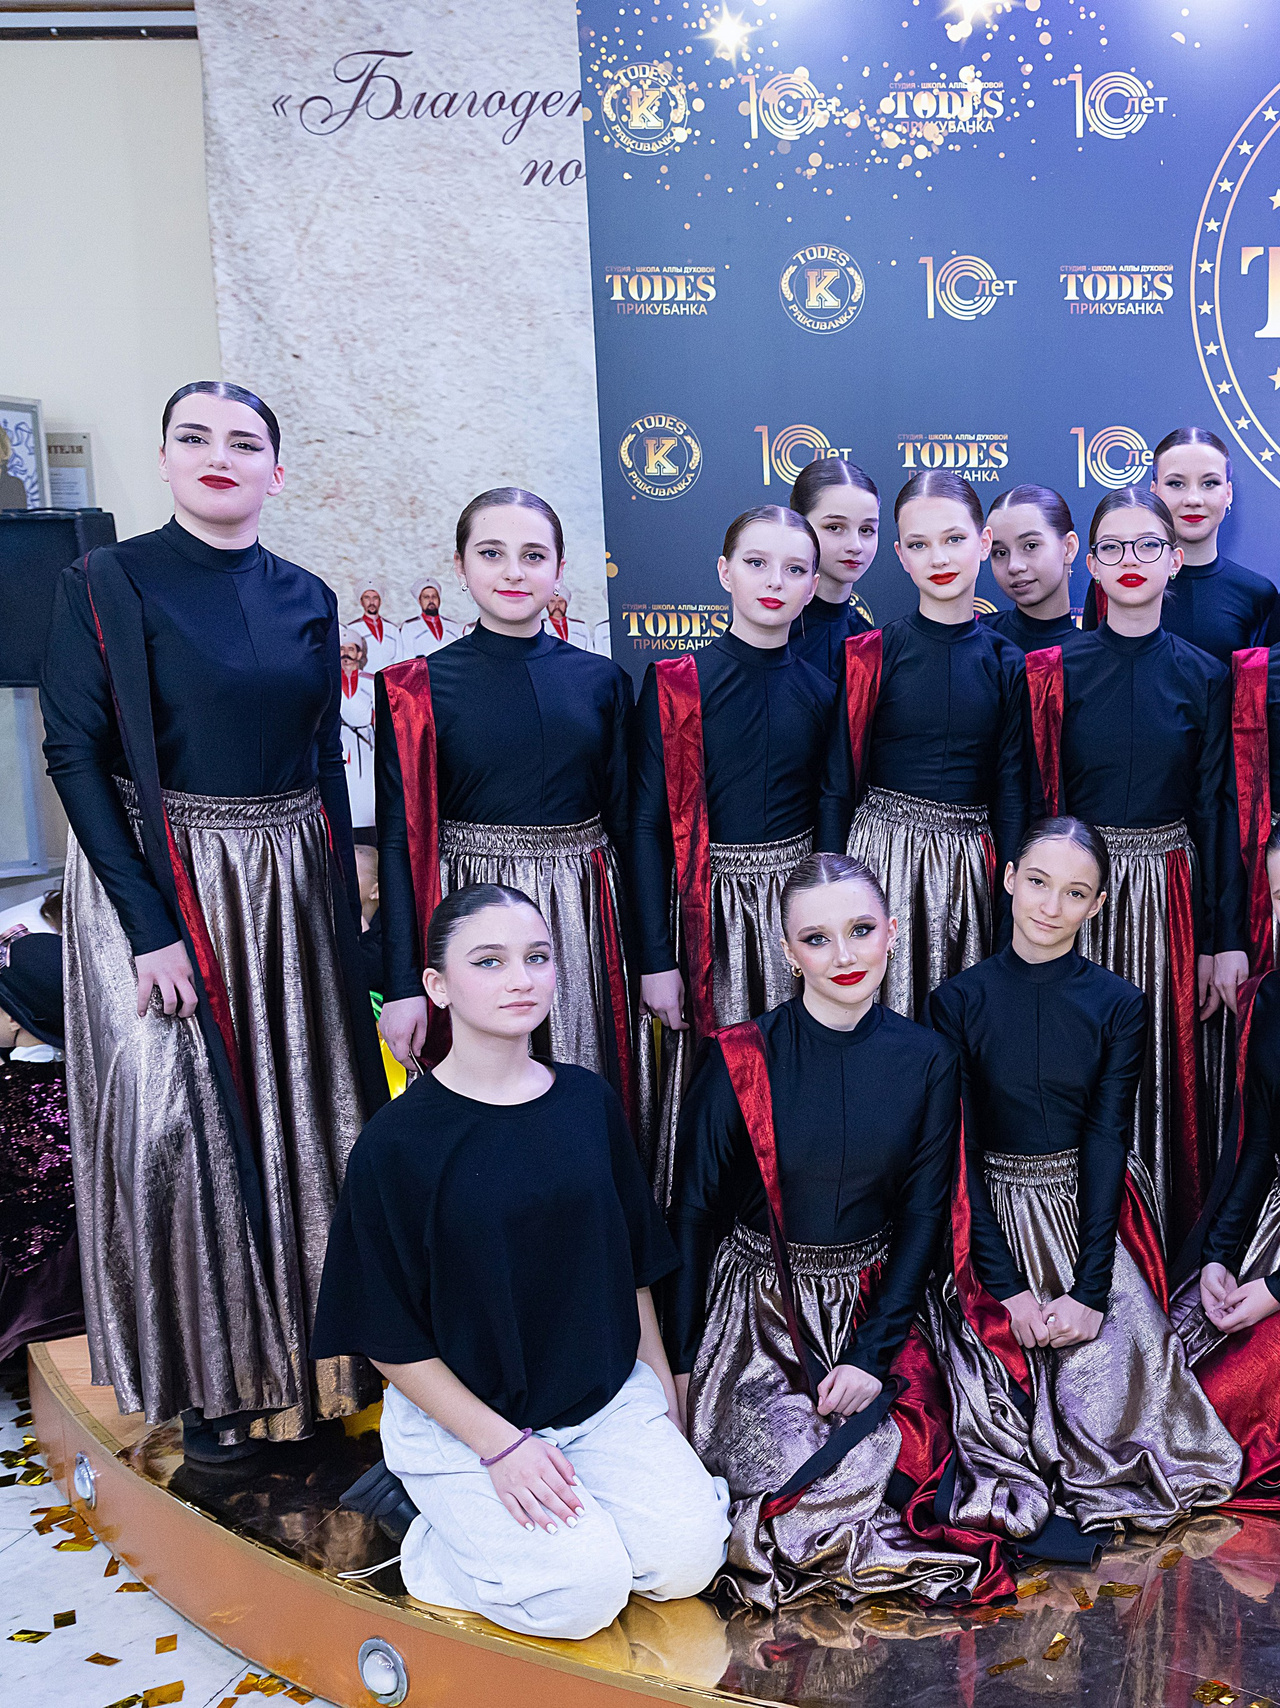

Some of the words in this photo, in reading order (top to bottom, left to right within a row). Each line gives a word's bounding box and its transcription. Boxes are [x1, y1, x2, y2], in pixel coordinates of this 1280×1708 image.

[614, 65, 672, 87] TODES
[627, 88, 664, 129] K
[889, 91, 1005, 119] TODES
[1067, 71, 1148, 139] 10
[1125, 96, 1168, 113] лет
[611, 124, 683, 151] PRIKUBANK
[793, 246, 850, 267] TODES
[605, 274, 717, 301] TODES
[804, 268, 841, 309] K
[918, 255, 998, 320] 10
[976, 279, 1018, 296] лет
[1060, 273, 1174, 301] TODES
[617, 303, 708, 315] ПРИКУБАНКА
[788, 304, 858, 331] PRIKUBANKA
[1070, 303, 1164, 315] ПРИКУБАНКА
[631, 414, 687, 436] TODES
[644, 437, 679, 476] K
[897, 441, 1009, 468] TODES
[1070, 425, 1149, 489] 10
[1125, 450, 1154, 466] ле
[628, 470, 695, 497] PRIKUBANKA
[622, 612, 729, 638] TODES
[633, 639, 713, 650] ПРИКУБАН
